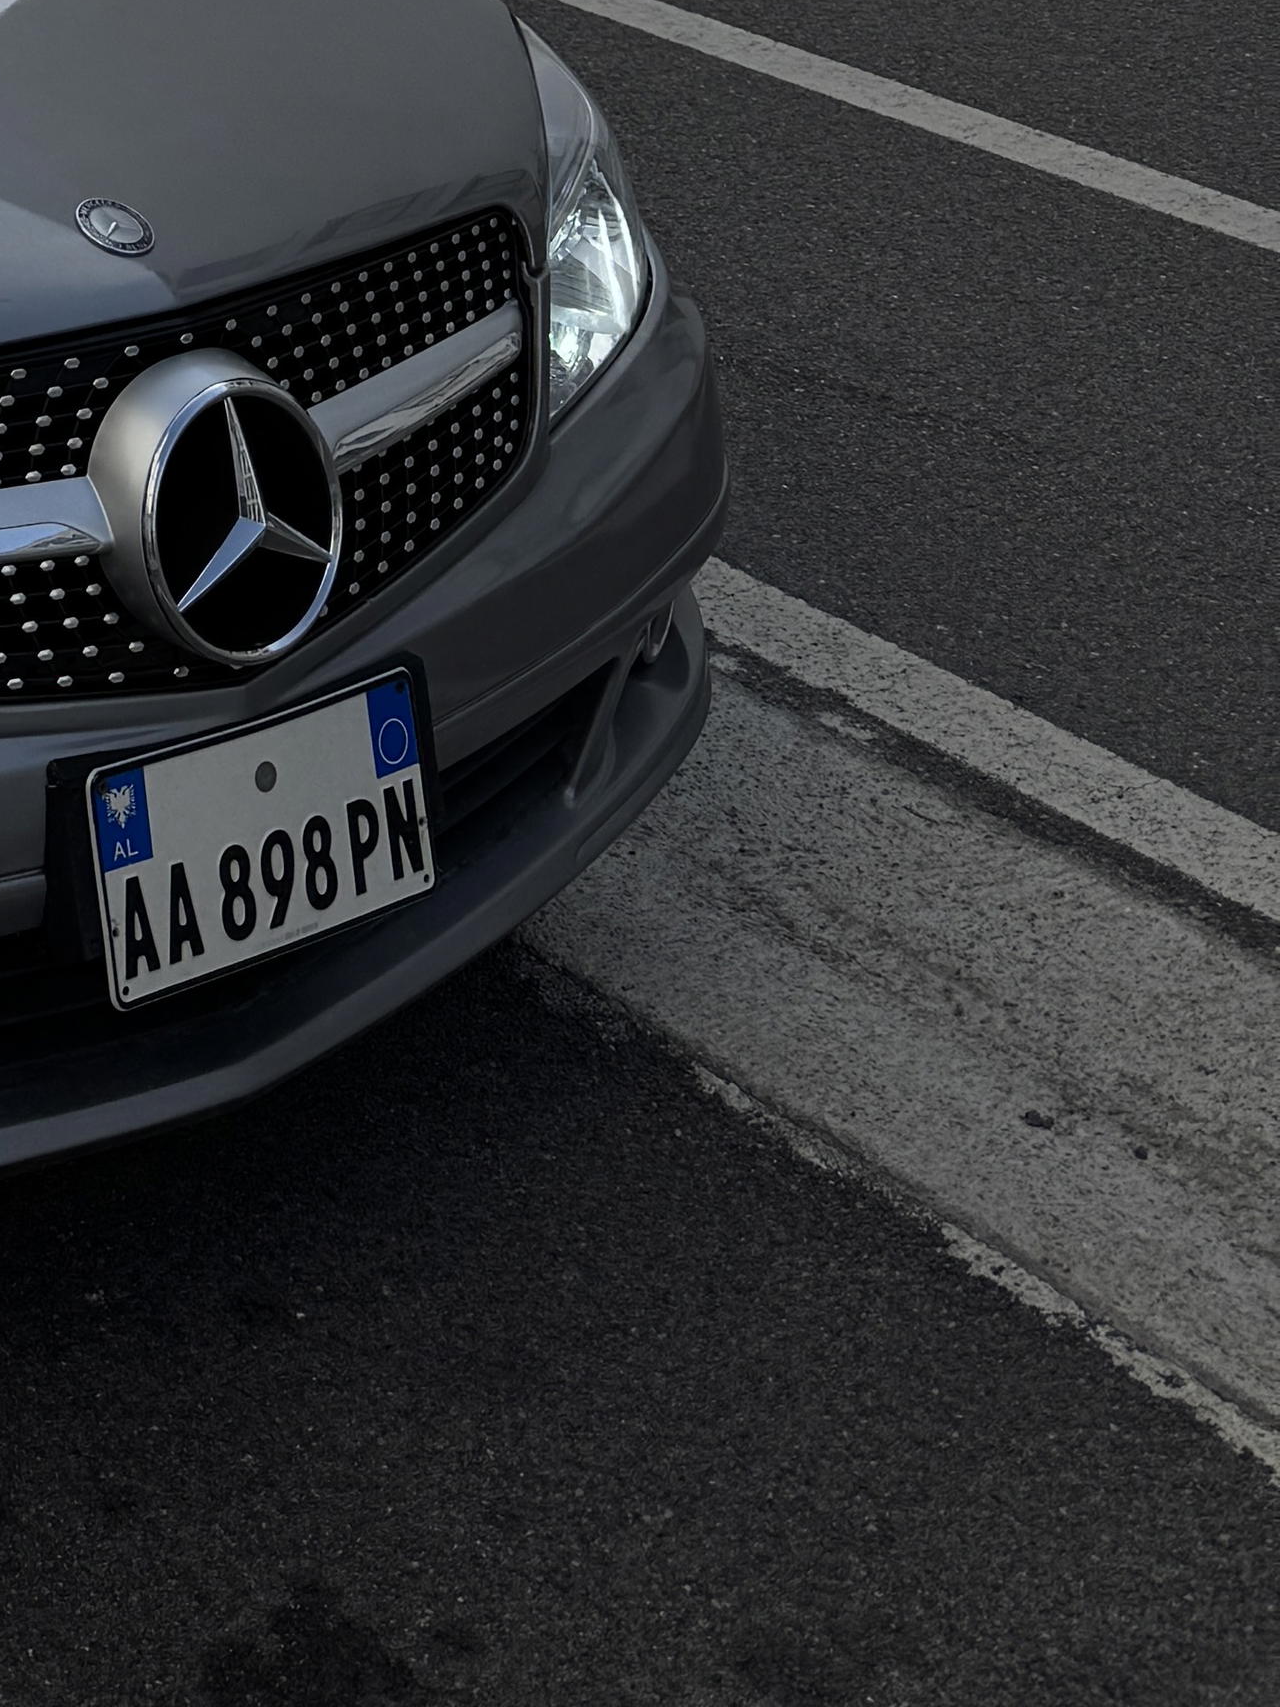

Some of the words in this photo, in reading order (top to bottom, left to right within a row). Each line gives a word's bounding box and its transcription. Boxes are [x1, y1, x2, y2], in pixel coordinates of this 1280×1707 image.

[114, 838, 139, 862] AL
[125, 862, 205, 980] AA
[219, 815, 338, 941] 898
[346, 779, 423, 896] PN
